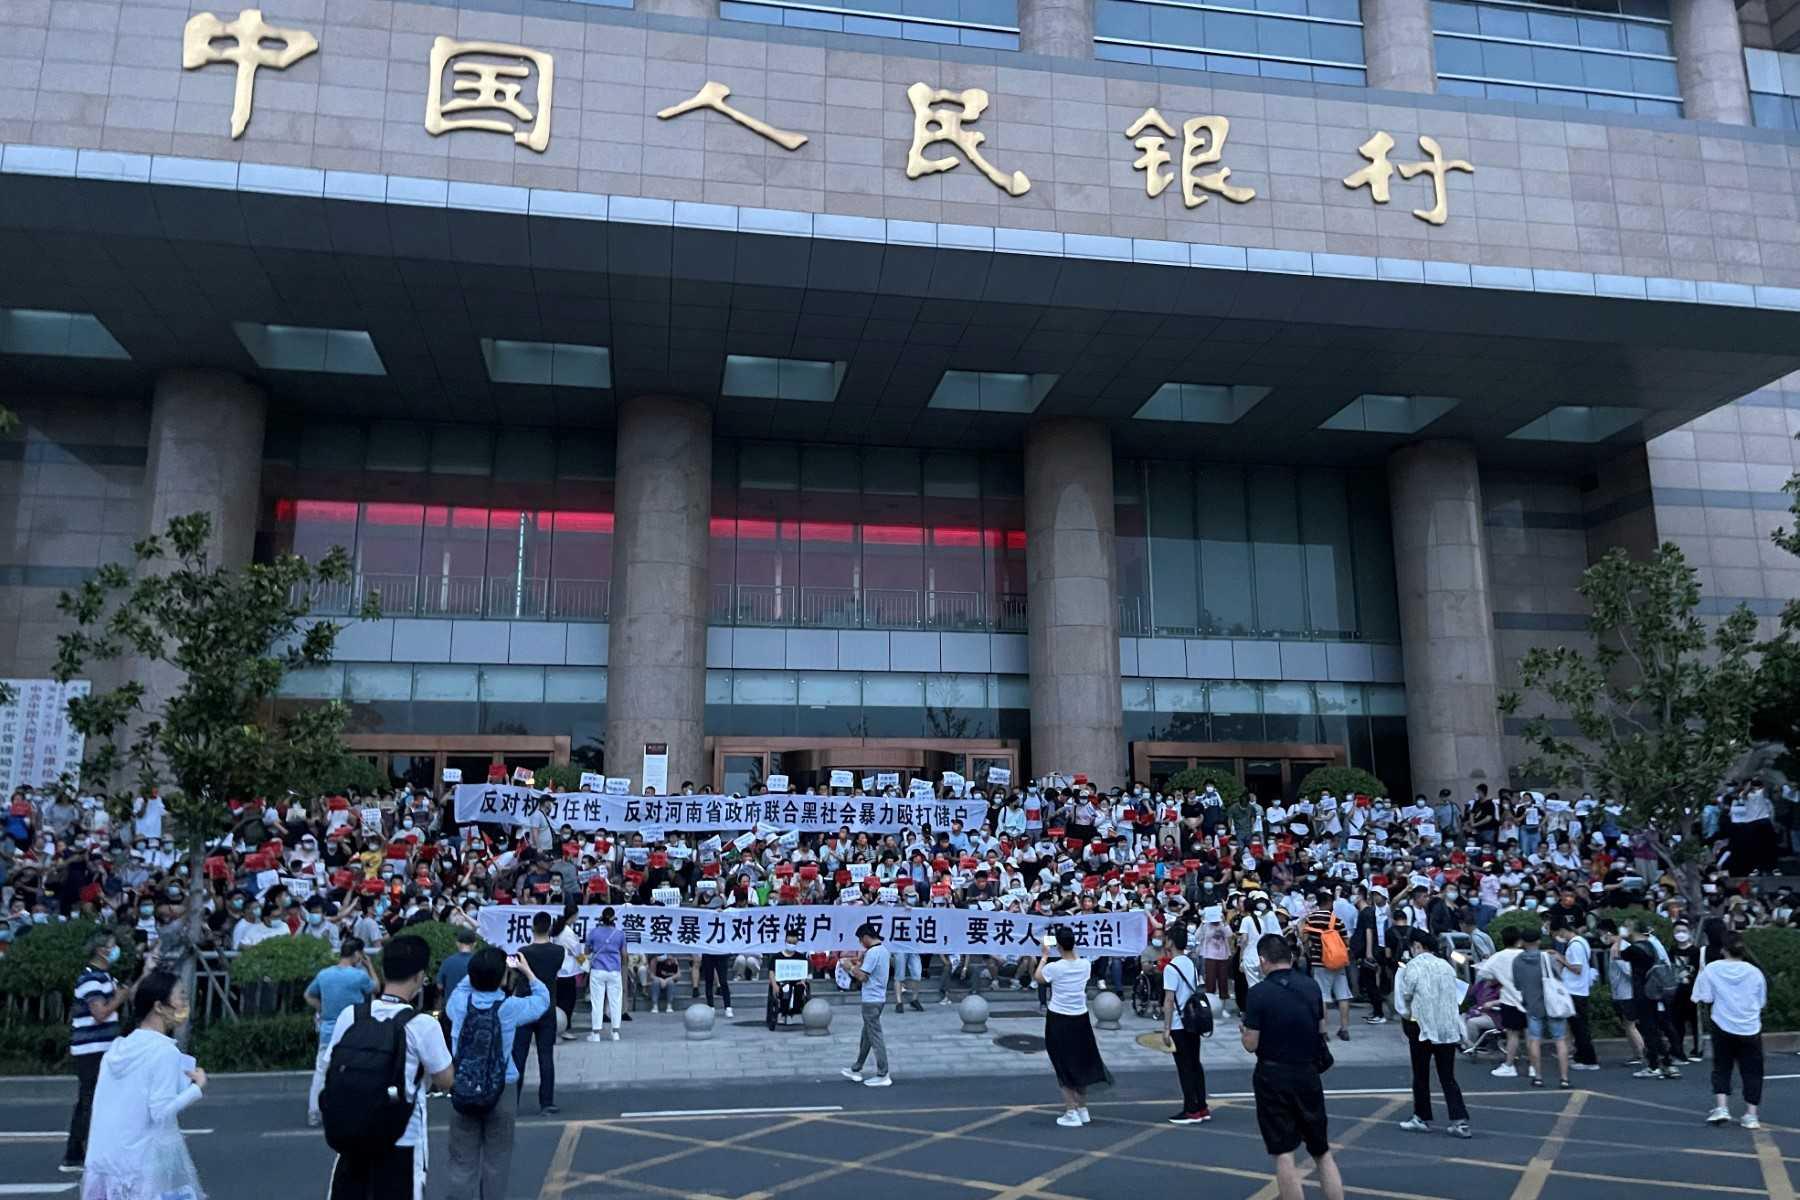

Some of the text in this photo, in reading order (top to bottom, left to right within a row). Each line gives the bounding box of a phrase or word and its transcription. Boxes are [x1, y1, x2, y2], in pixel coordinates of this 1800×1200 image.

[182, 9, 1473, 226] 中国人民银行
